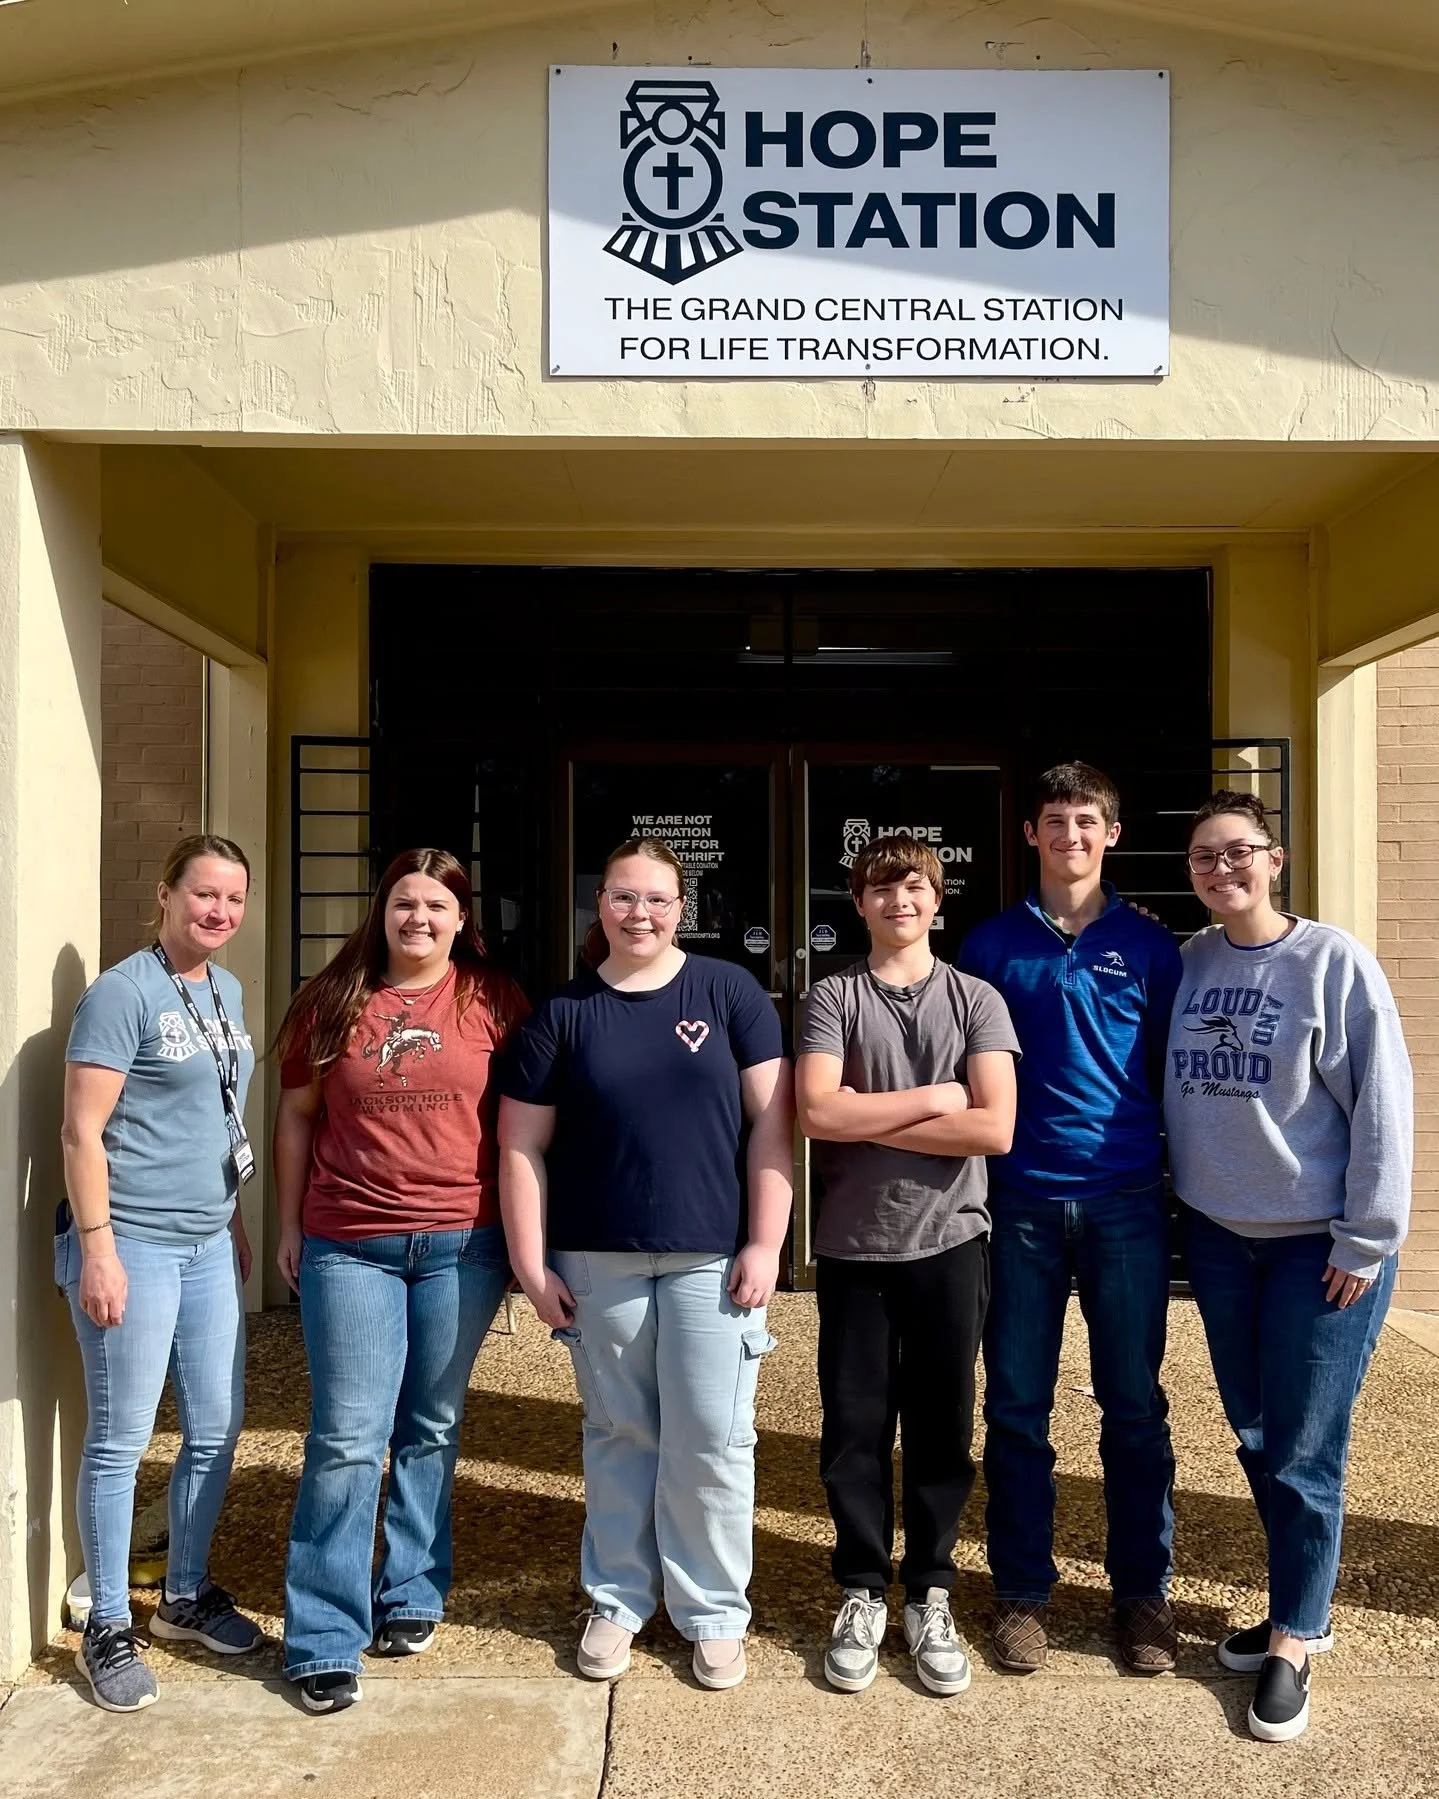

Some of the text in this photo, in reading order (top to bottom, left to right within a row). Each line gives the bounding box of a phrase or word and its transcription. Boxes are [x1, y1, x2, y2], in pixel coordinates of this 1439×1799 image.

[744, 110, 998, 169] HOPE
[742, 190, 1116, 250] STATION
[604, 297, 1124, 322] THE GRAND CENTRAL STATION
[619, 336, 1110, 361] FOR LIFE TRANSFORMATION.
[632, 815, 713, 825] WE ARE NOT
[631, 827, 711, 837] A DONATION
[877, 826, 943, 842] HOPE
[664, 839, 719, 849] OFF FOR
[677, 852, 725, 862] THRIFT
[1092, 965, 1128, 978] SLOCUM
[1183, 987, 1263, 1016] LOUD
[1172, 1049, 1272, 1084] PROUD
[421, 1093, 463, 1103] HOLE
[1180, 1081, 1261, 1102] Go Mustangs
[361, 1103, 449, 1114] WYOMING
